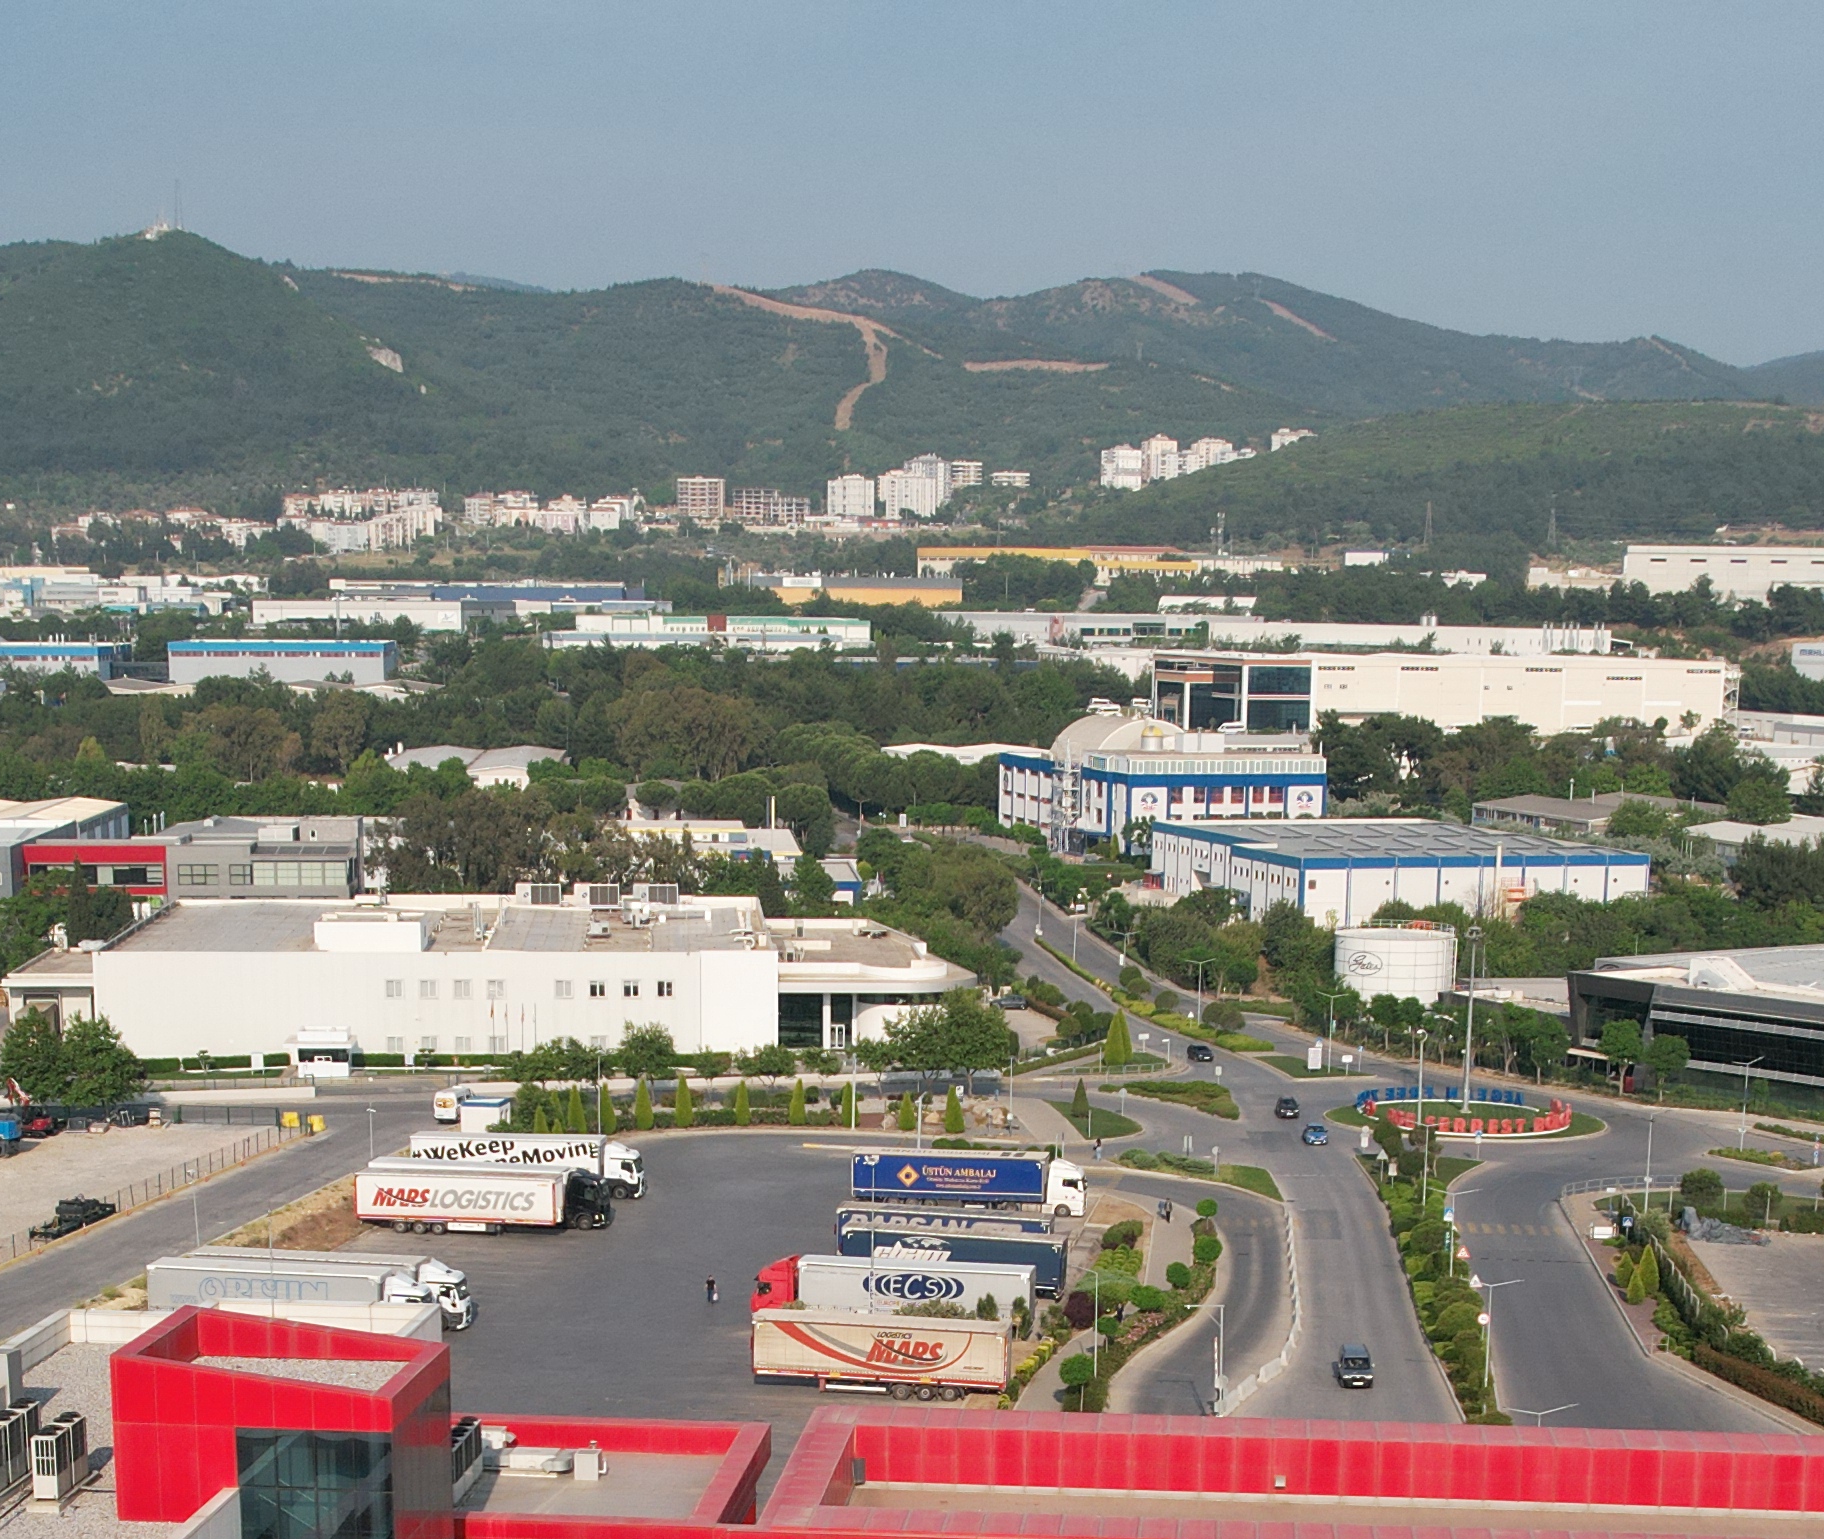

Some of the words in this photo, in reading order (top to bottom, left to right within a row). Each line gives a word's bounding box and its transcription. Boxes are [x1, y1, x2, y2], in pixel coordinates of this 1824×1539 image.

[412, 1140, 516, 1161] #WeKeep
[922, 1164, 953, 1177] ÜSTÜN
[954, 1167, 997, 1179] AMBALAJ
[372, 1186, 431, 1208] MARS
[428, 1188, 536, 1211] LOGISTICS
[889, 1274, 939, 1298] ECS
[876, 1331, 912, 1339] LOGISTICS
[866, 1338, 945, 1365] MARS
